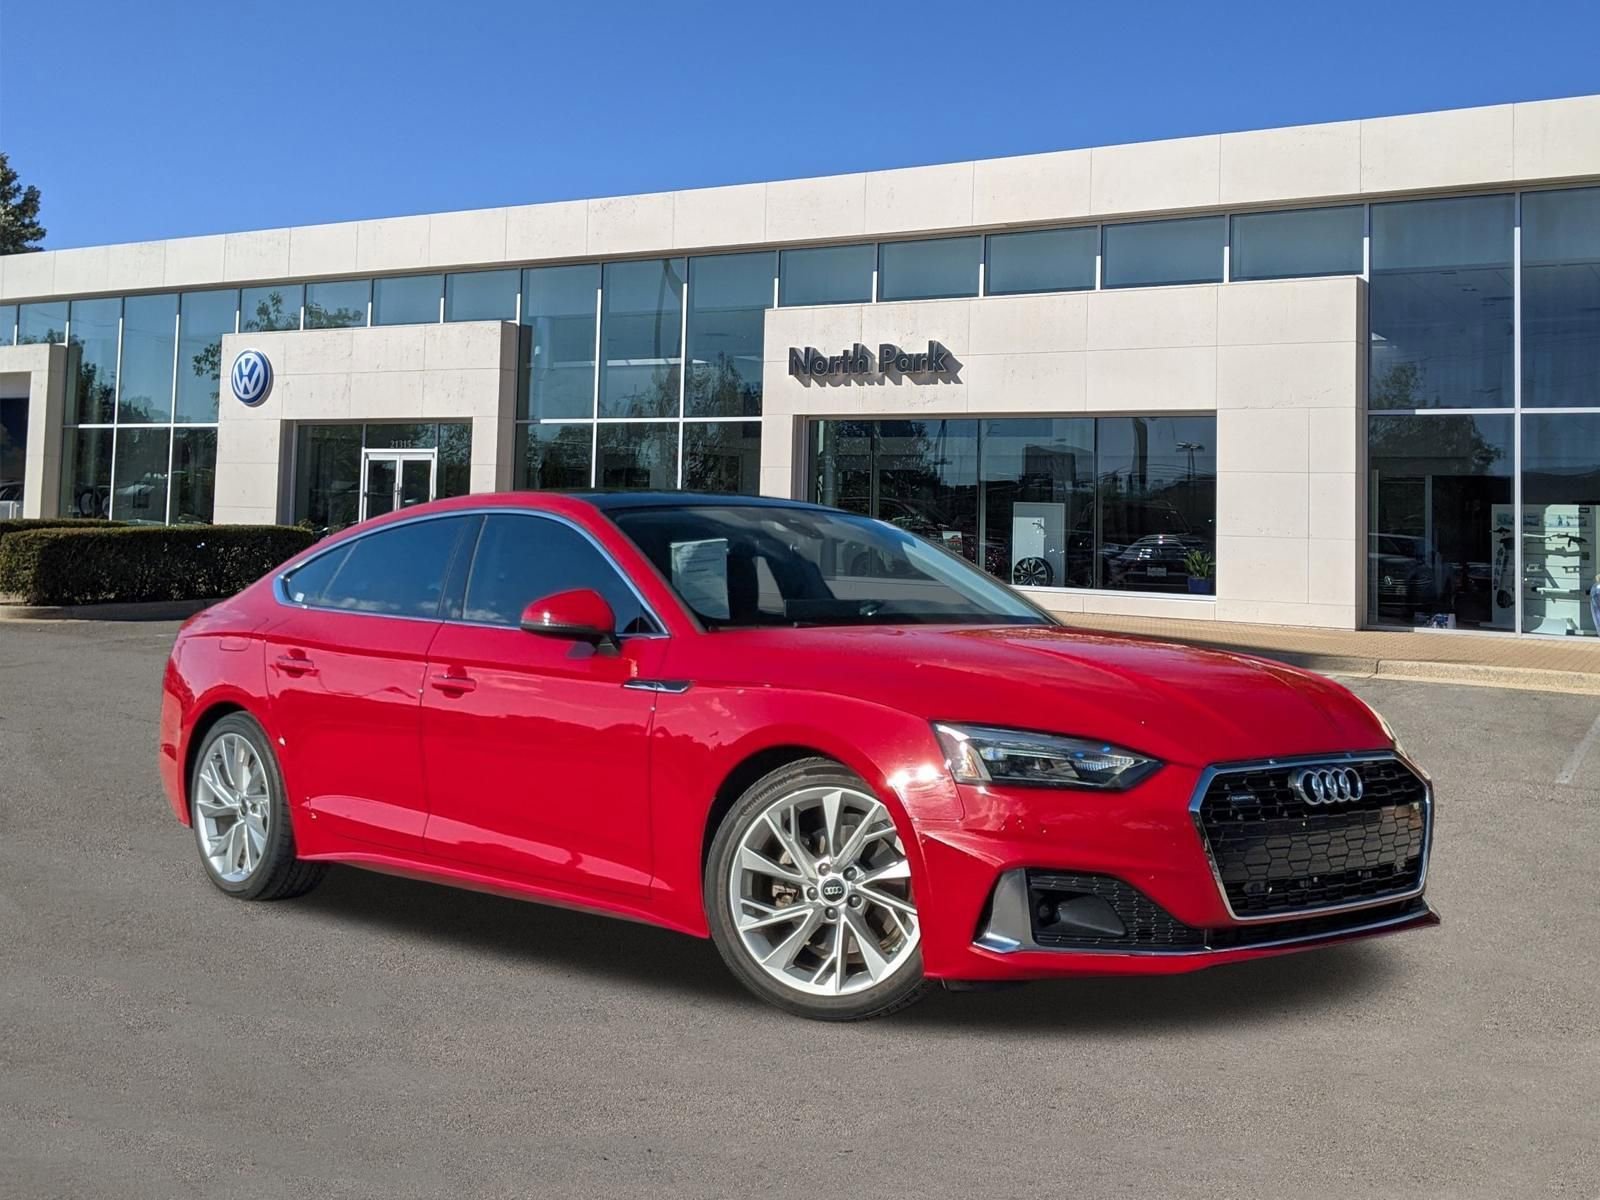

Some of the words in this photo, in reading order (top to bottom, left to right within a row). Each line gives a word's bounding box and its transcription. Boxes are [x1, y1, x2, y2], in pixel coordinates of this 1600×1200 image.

[233, 353, 265, 399] VW
[788, 342, 872, 376] North
[878, 339, 948, 374] Park
